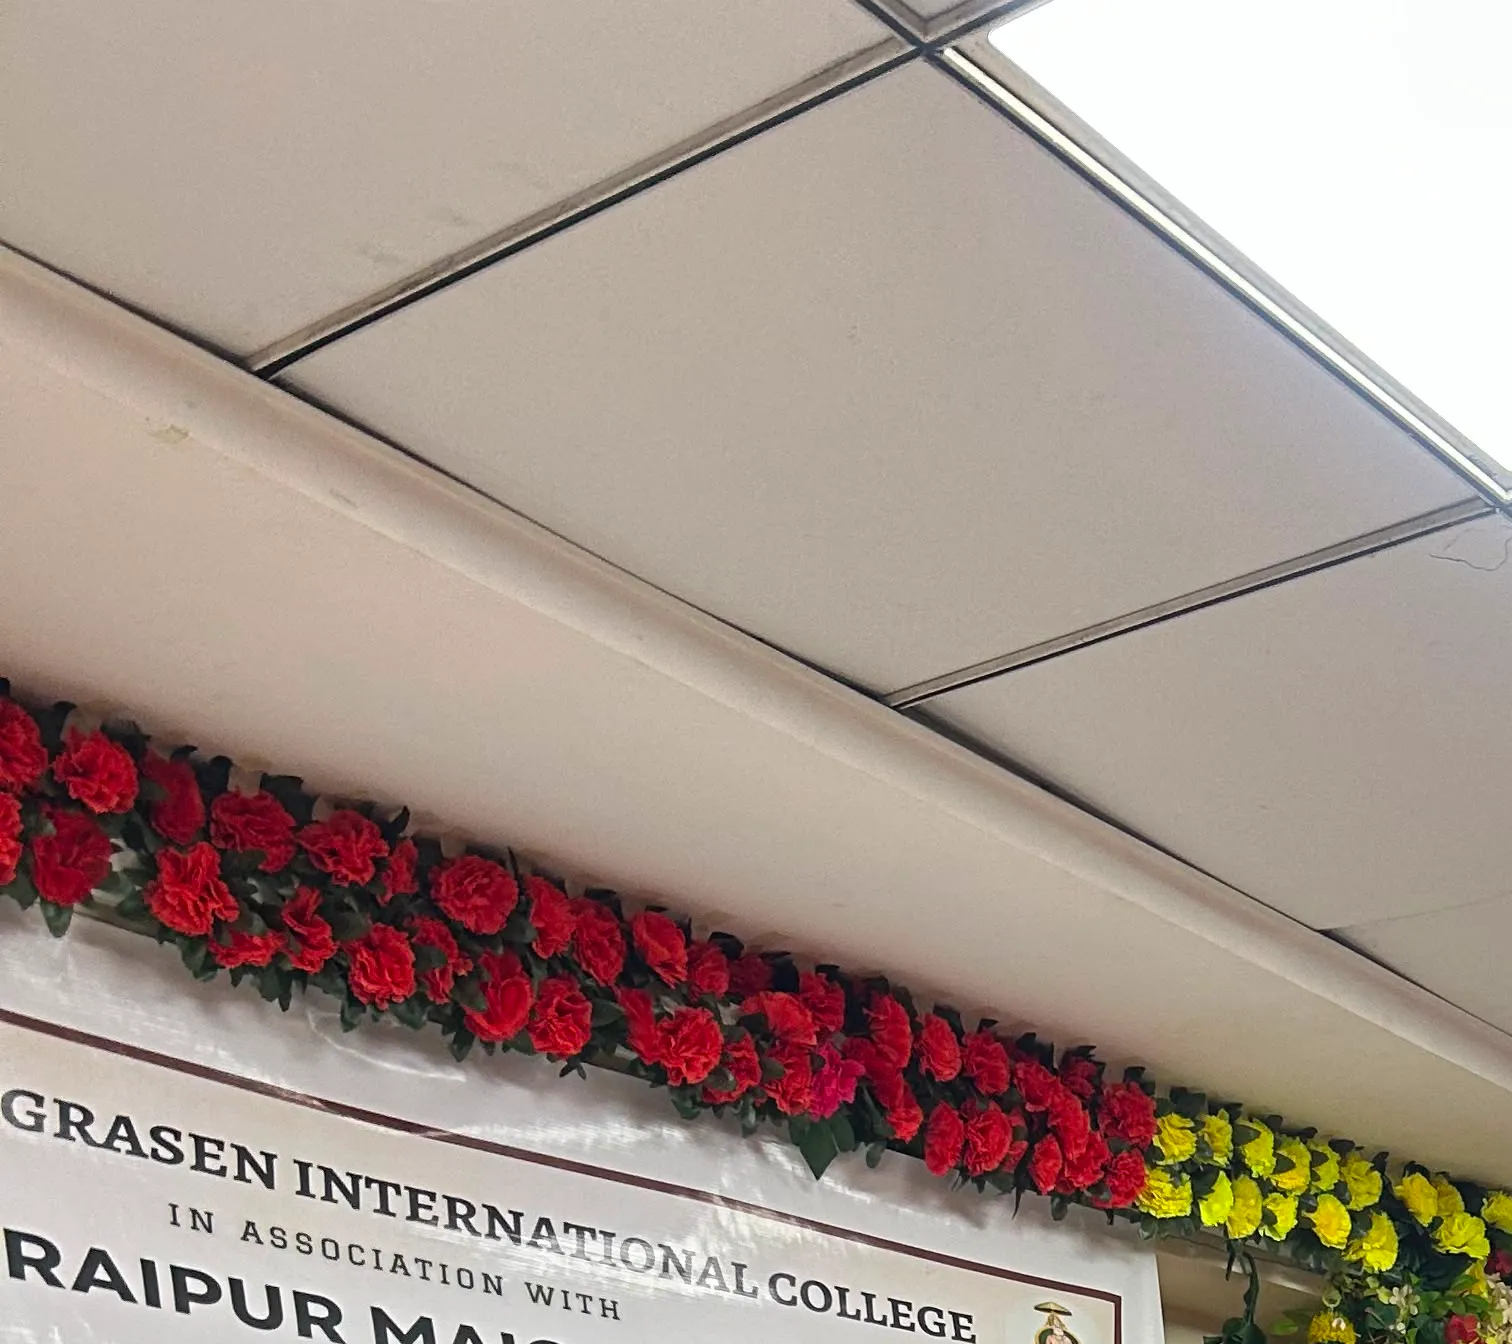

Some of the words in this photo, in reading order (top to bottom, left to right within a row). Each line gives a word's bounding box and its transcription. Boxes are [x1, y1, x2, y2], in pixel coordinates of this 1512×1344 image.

[1, 1088, 278, 1190] GRASEN
[294, 1159, 758, 1299] INTERNATIONAL
[769, 1272, 978, 1344] COLLEGE
[168, 1203, 214, 1235] IN
[240, 1220, 503, 1297] ASSOCIATION
[525, 1282, 621, 1321] WITH
